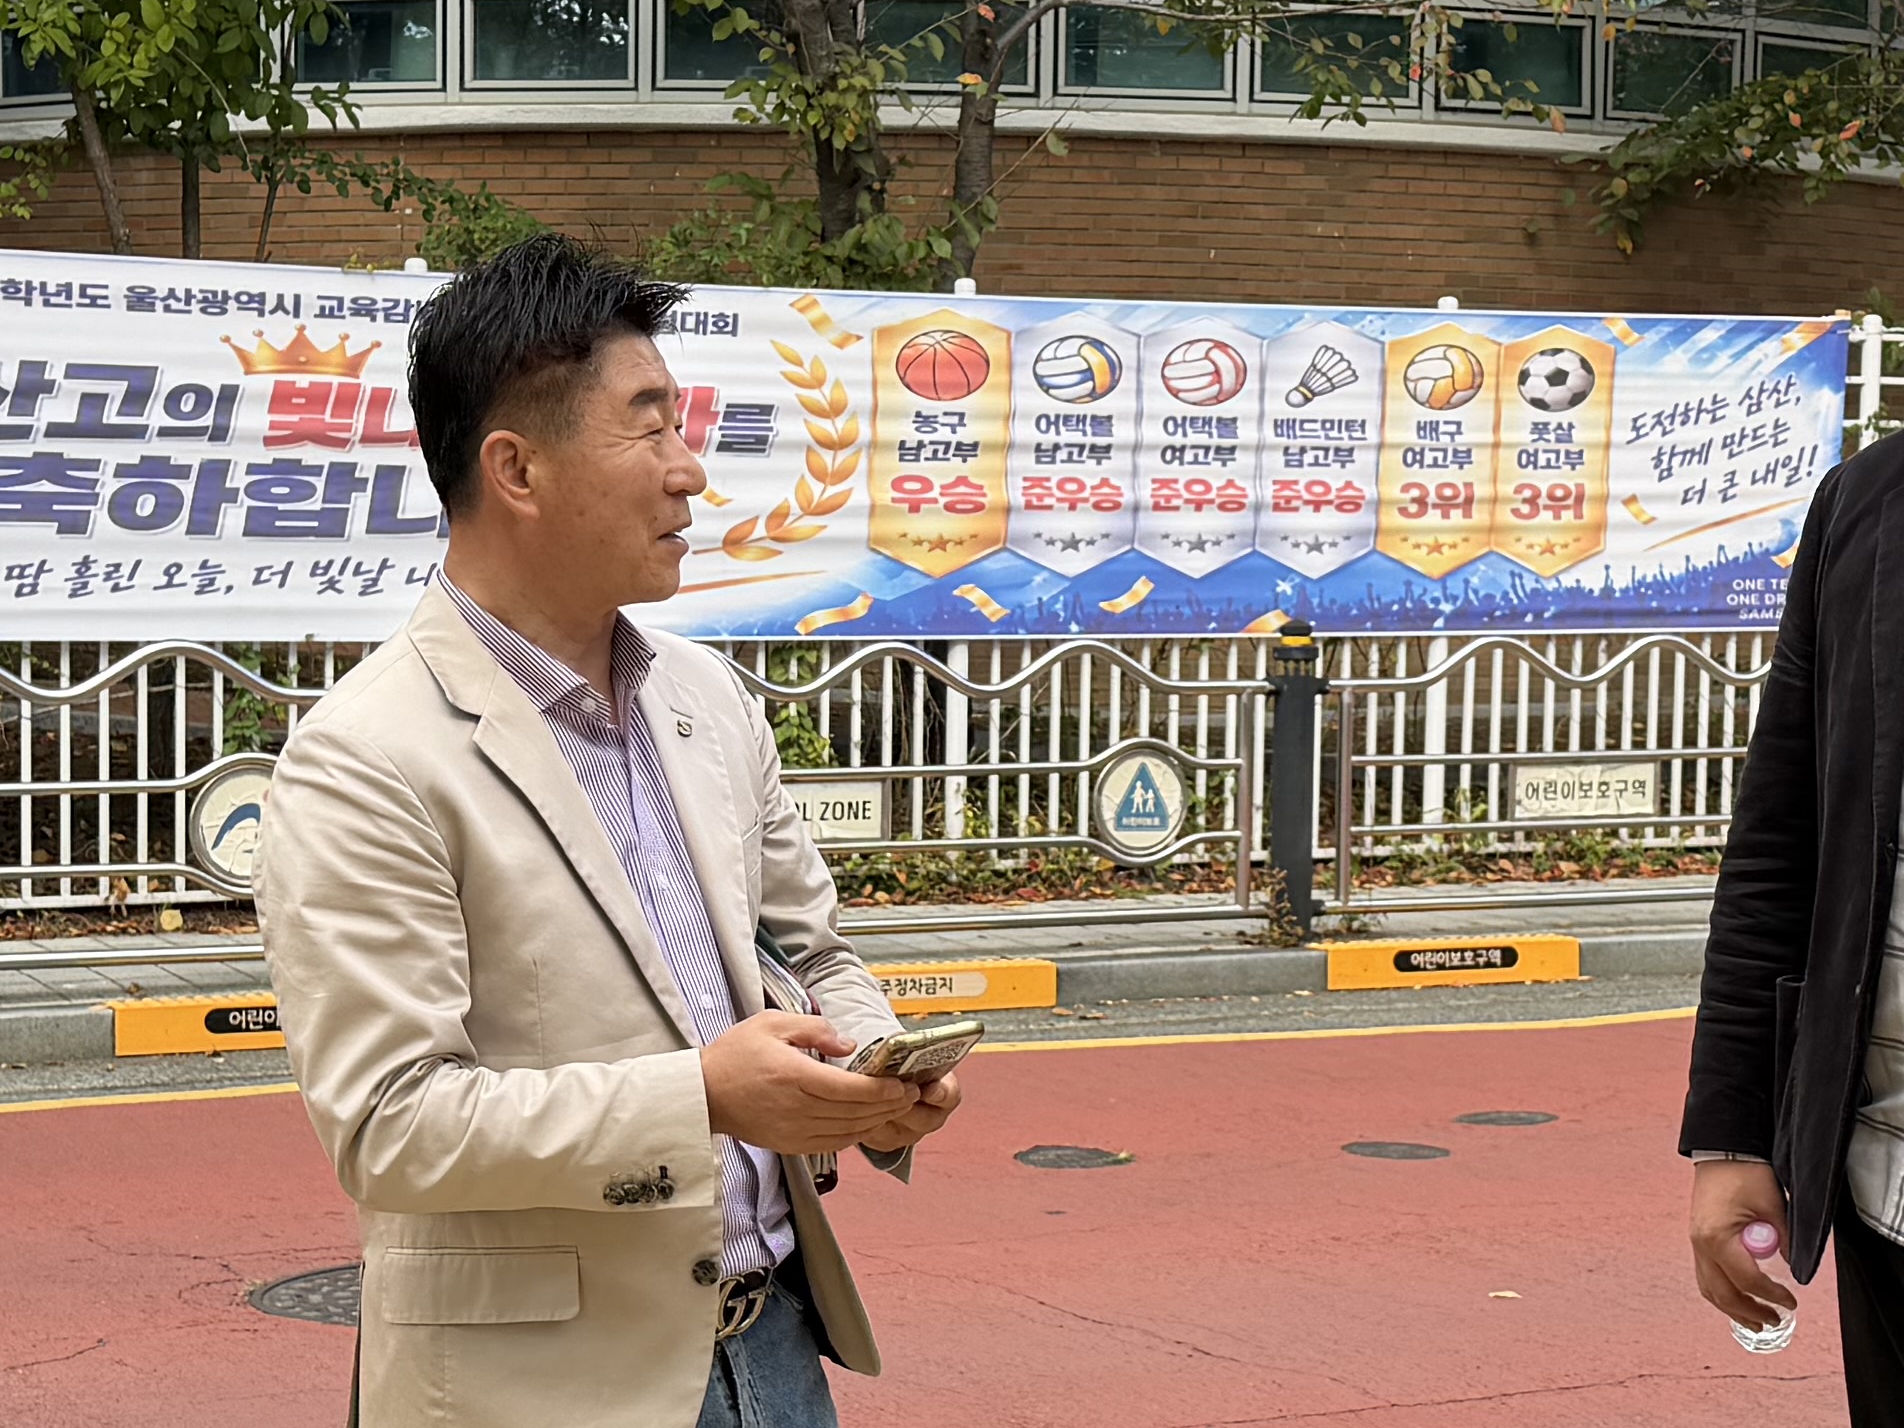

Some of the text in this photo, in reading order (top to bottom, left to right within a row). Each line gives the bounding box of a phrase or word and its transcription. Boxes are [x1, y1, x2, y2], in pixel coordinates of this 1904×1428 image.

[123, 283, 303, 320] 울산광역시
[313, 293, 422, 324] 교육감
[1625, 374, 1802, 445] 도전하는 삼산,
[911, 410, 968, 436] 농구
[1034, 413, 1115, 439] 어택볼
[1162, 415, 1240, 440] 어택볼
[1273, 417, 1368, 441] 배드민턴
[1415, 419, 1464, 444] 배구
[1528, 420, 1575, 444] 풋살
[897, 440, 979, 465] 남고부
[1034, 441, 1113, 466] 남고부
[1160, 442, 1238, 468] 여고부
[1282, 445, 1356, 469] 남고부
[1401, 446, 1474, 471] 여고부
[1516, 446, 1586, 472] 여고부
[1650, 417, 1792, 483] 함께 만드는
[1680, 444, 1819, 506] 더 큰 내일!
[889, 474, 988, 516] 우승
[1020, 475, 1124, 513] 준우승
[1150, 478, 1249, 513] 준우승
[1272, 479, 1367, 514] 준우승
[1396, 481, 1475, 520] 3위
[1509, 482, 1586, 520] 3위
[4, 560, 55, 598] 땀
[152, 559, 234, 596] 오늘,
[250, 560, 289, 589] 더
[308, 556, 386, 596] 빛날
[1732, 578, 1788, 591] ONE TE
[1726, 593, 1786, 606] ONE DR
[1739, 608, 1783, 620] SAMS
[1524, 779, 1647, 802] 어린이보호구역
[819, 800, 872, 822] ZONE
[1410, 948, 1502, 969] 어린이보호구역
